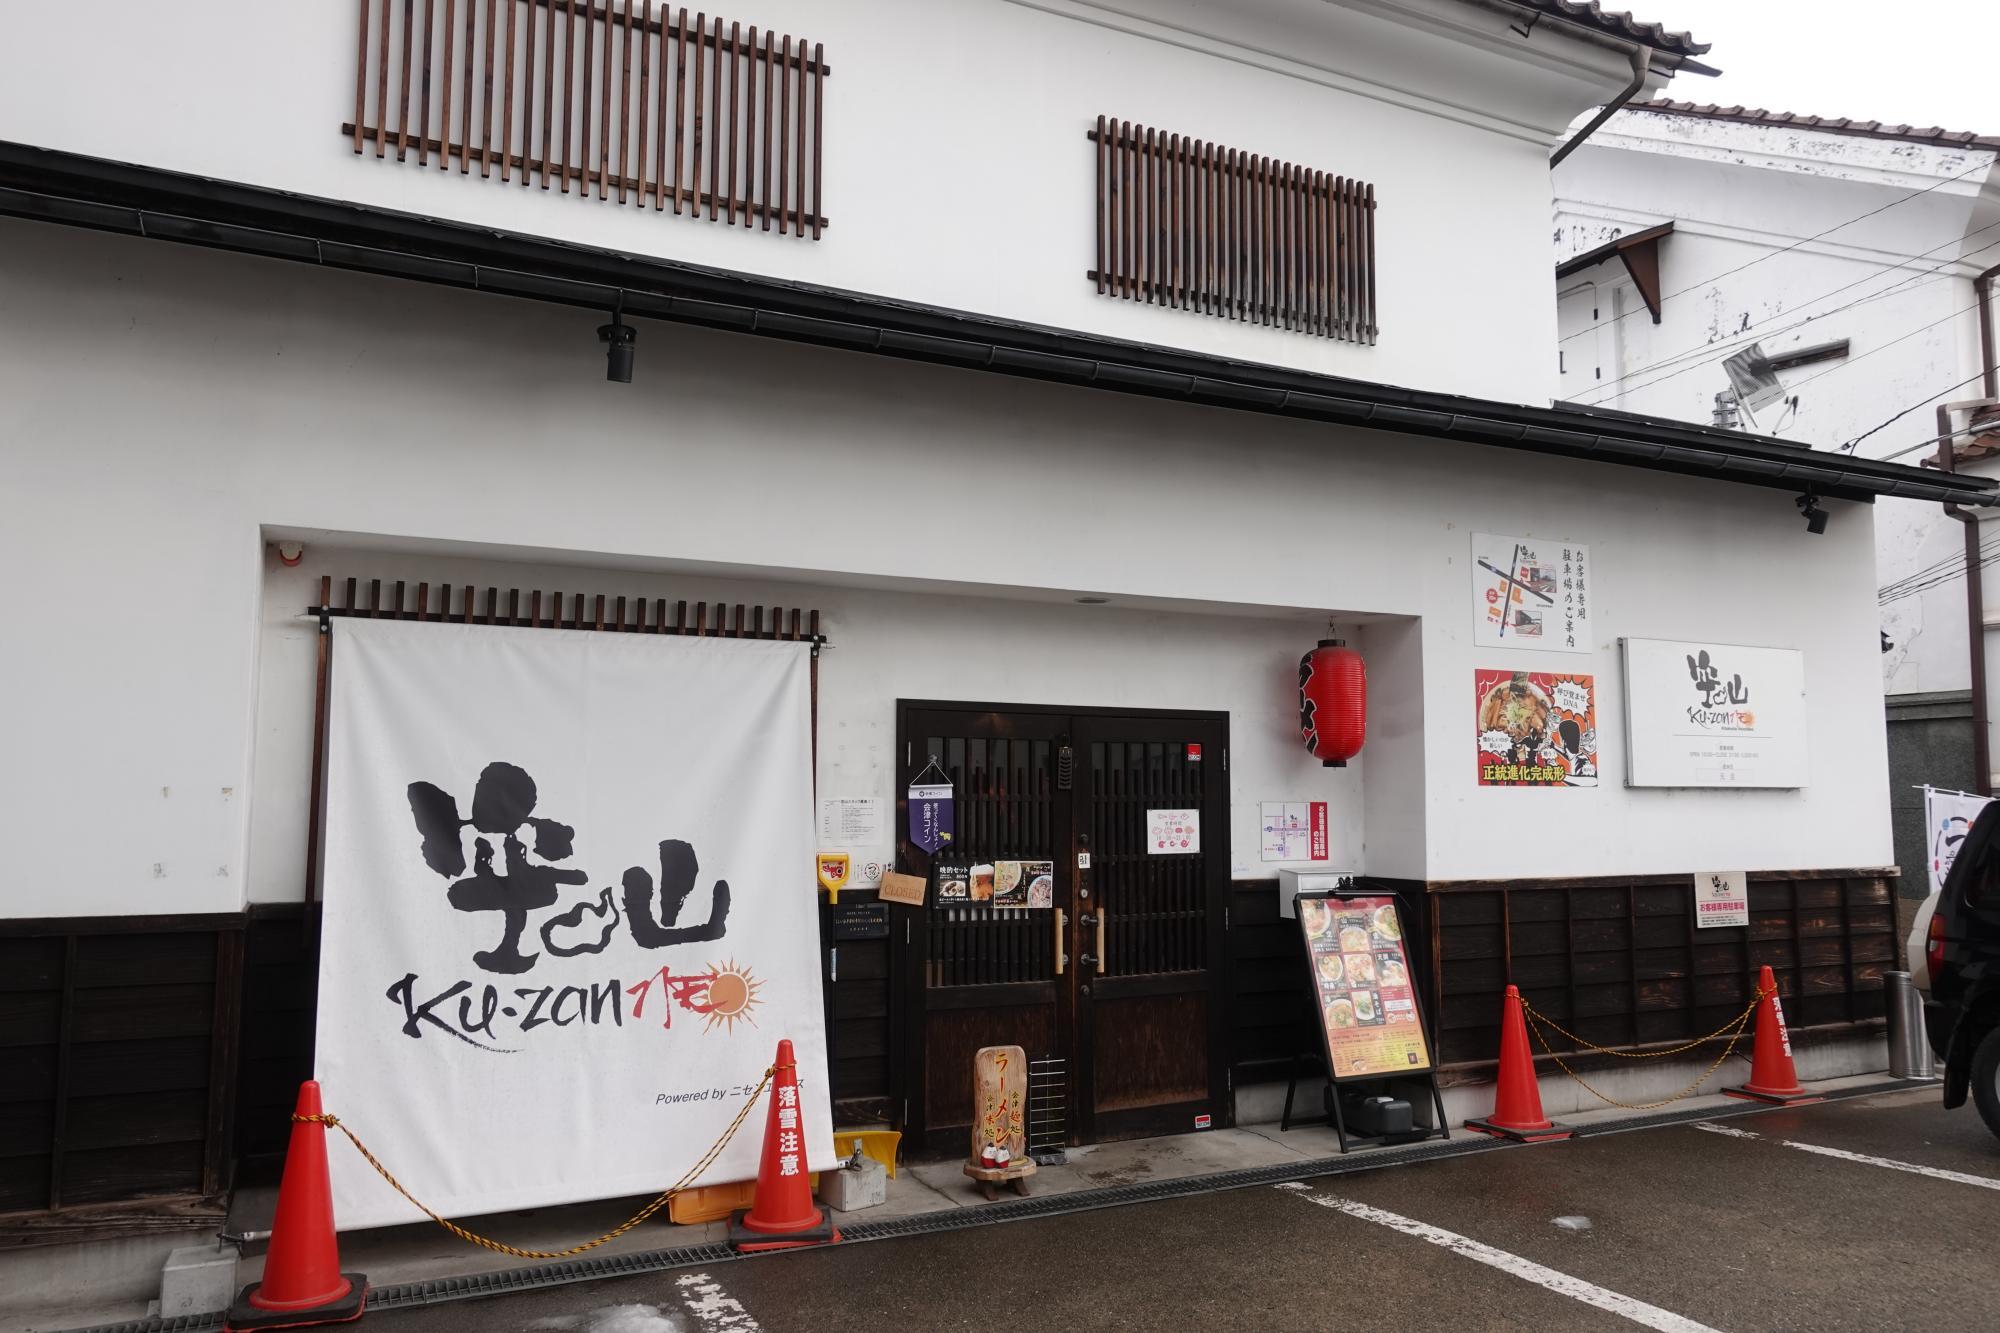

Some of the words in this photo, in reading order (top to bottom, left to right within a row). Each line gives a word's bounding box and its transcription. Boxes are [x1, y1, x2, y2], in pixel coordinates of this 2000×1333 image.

[1562, 548, 1575, 648] 駐車場のご案内
[1563, 699, 1579, 709] DNA
[1483, 765, 1565, 781] 正統進化完成形
[923, 802, 931, 843] 会津コイン
[939, 865, 968, 874] 晩酌セット
[884, 884, 923, 901] CLOSED
[655, 1089, 709, 1105] Powered
[712, 1088, 726, 1100] by
[996, 1053, 1010, 1144] ラーメン
[779, 1086, 799, 1176] 落雪注意
